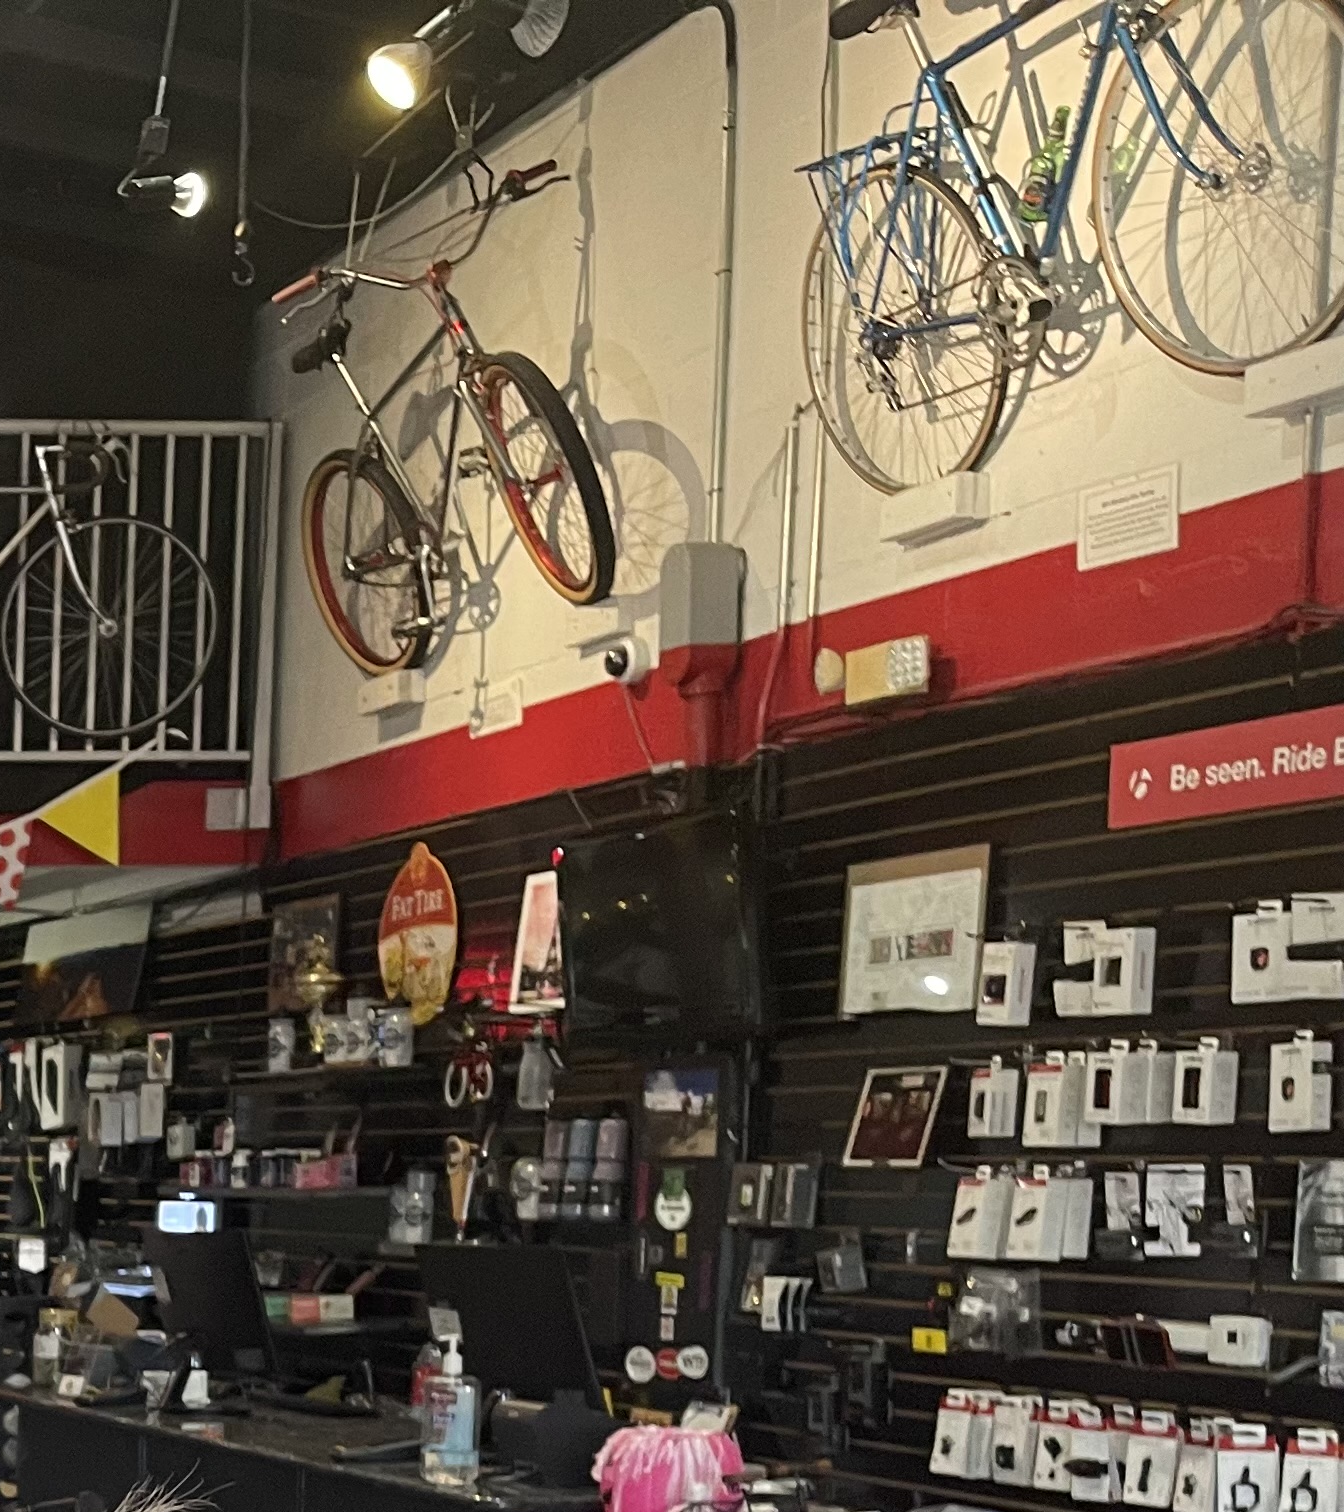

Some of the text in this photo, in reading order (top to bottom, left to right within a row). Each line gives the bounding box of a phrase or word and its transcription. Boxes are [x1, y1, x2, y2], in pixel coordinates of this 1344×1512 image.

[1170, 763, 1200, 792] Be
[1205, 757, 1266, 787] seen.
[1272, 742, 1327, 776] Ride
